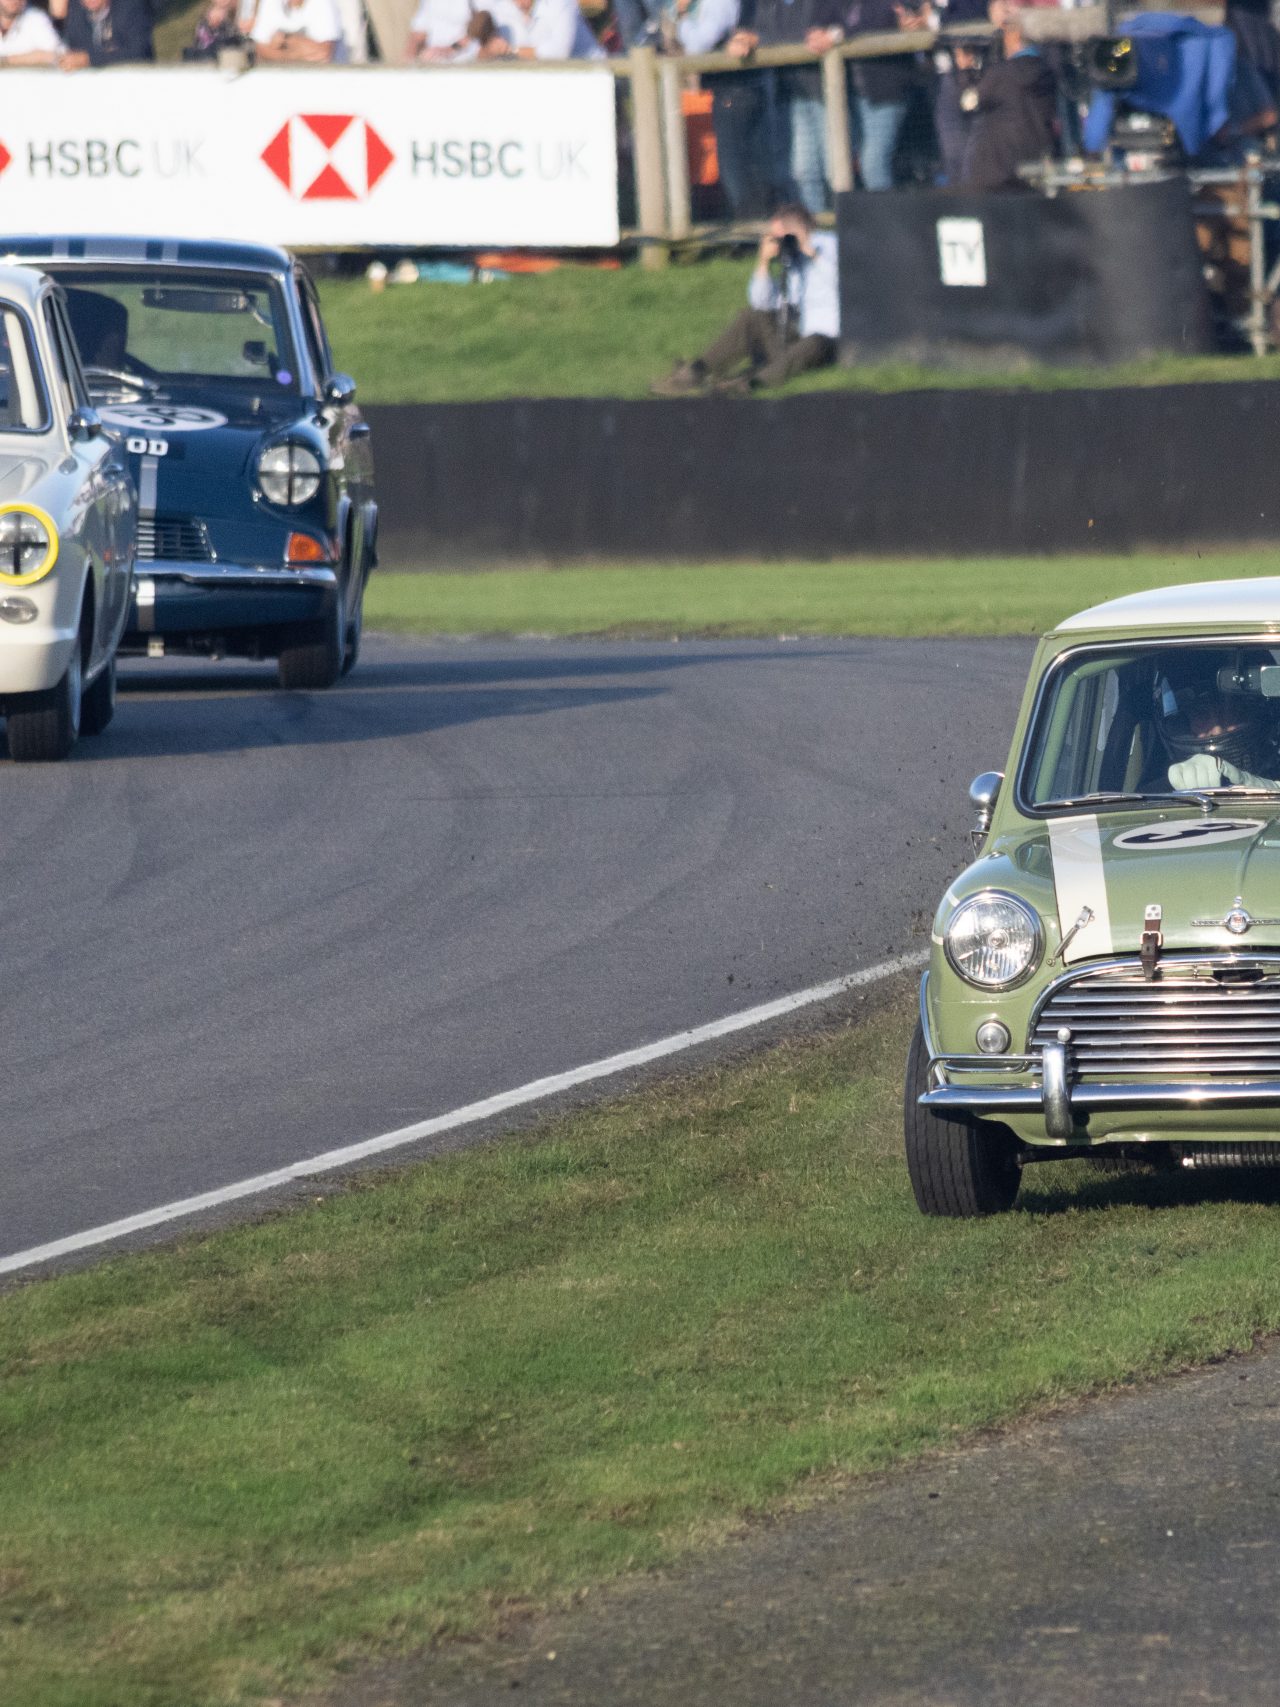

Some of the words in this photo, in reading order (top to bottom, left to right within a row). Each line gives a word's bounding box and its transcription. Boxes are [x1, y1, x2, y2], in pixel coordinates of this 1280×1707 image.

[27, 138, 142, 178] HSBC
[153, 140, 207, 180] UK
[410, 139, 525, 179] HSBC
[535, 140, 592, 182] UK
[943, 241, 980, 267] TV
